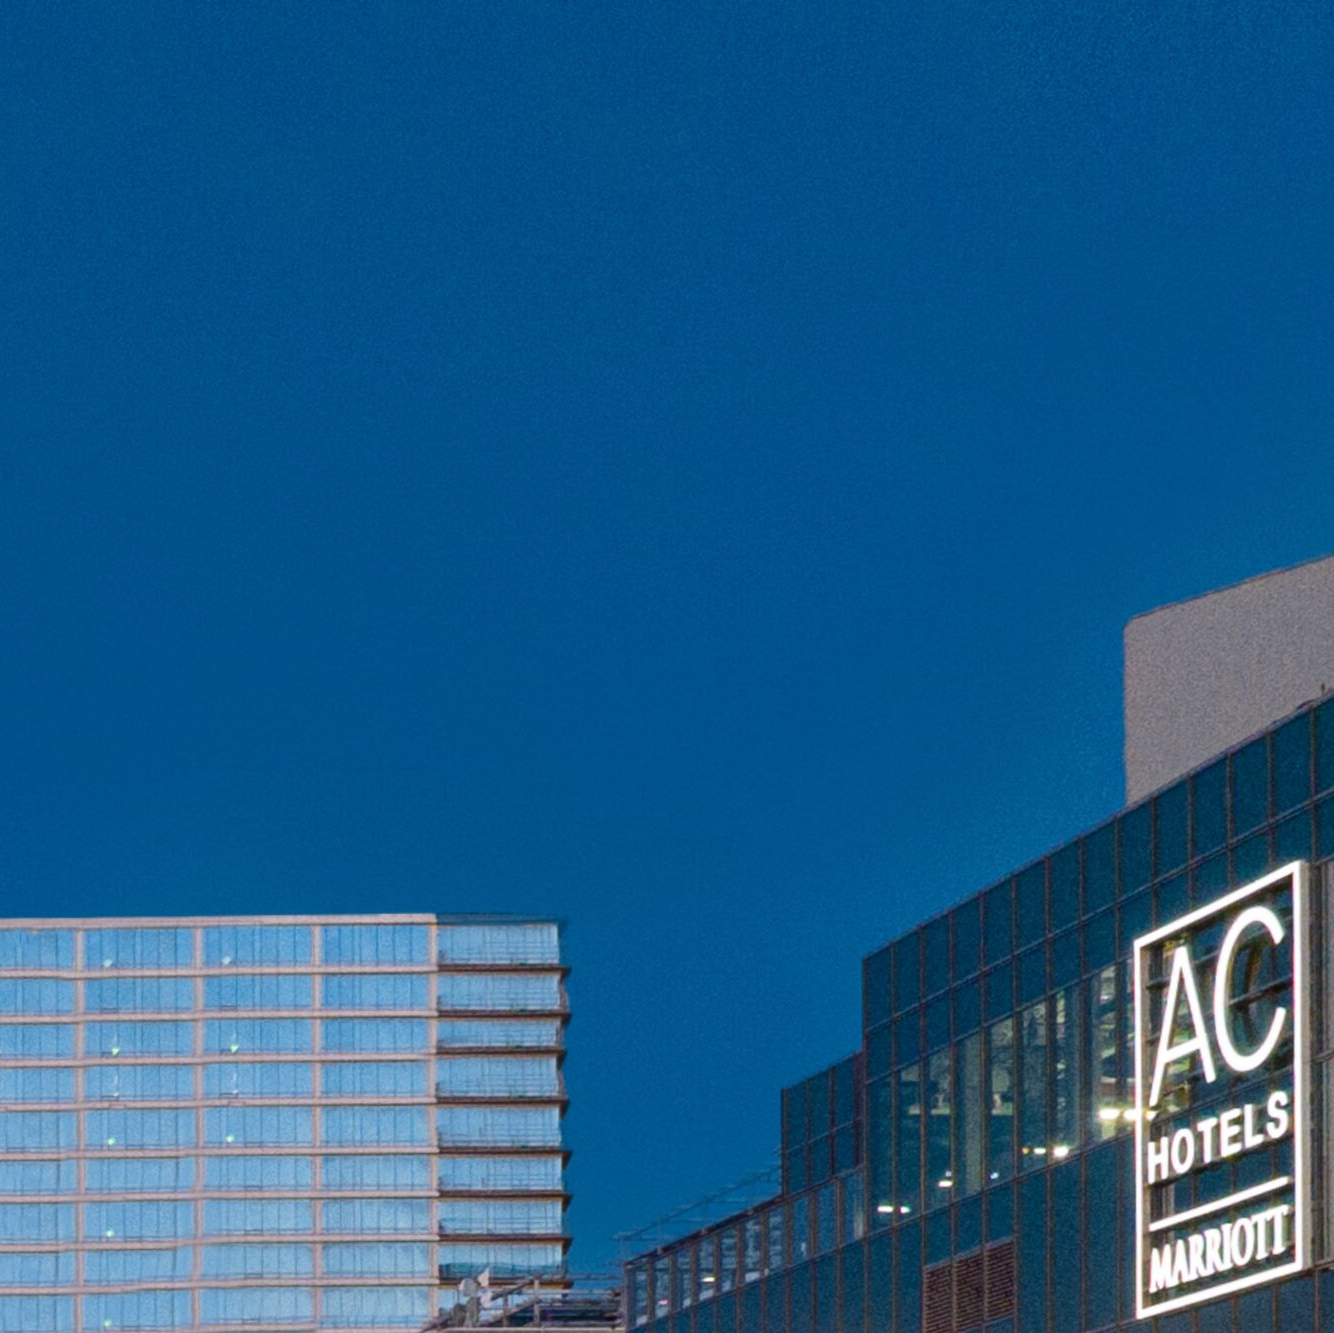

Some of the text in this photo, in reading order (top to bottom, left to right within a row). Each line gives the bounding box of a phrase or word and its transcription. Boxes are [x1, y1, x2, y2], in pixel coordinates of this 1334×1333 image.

[1150, 905, 1286, 1107] AC
[1147, 1090, 1289, 1185] HOTELS
[1148, 1204, 1289, 1294] MARRIOTT
